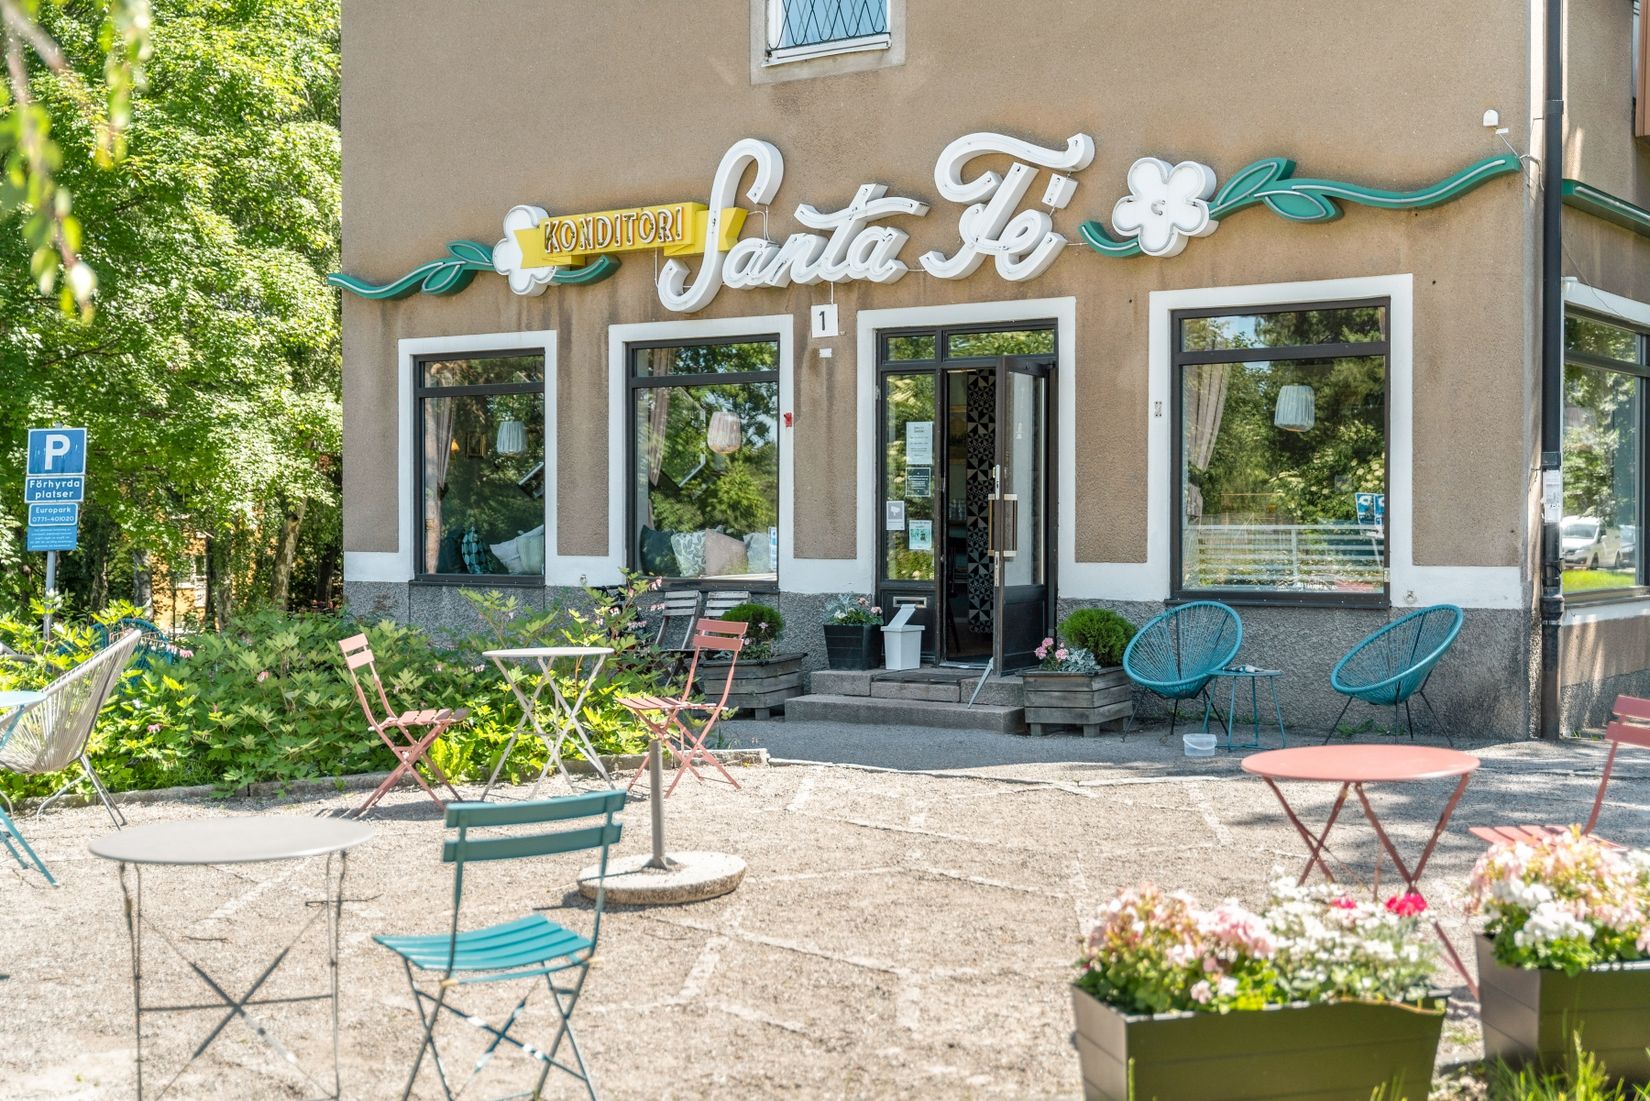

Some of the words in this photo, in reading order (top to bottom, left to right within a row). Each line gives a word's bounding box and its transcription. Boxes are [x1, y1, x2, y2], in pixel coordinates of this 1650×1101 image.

[544, 206, 686, 254] KONDITORI
[658, 138, 930, 313] Santa
[819, 311, 826, 331] 1
[45, 434, 71, 470] P
[29, 480, 80, 489] Förhyrda
[35, 490, 74, 500] platser
[35, 506, 71, 514] Europark
